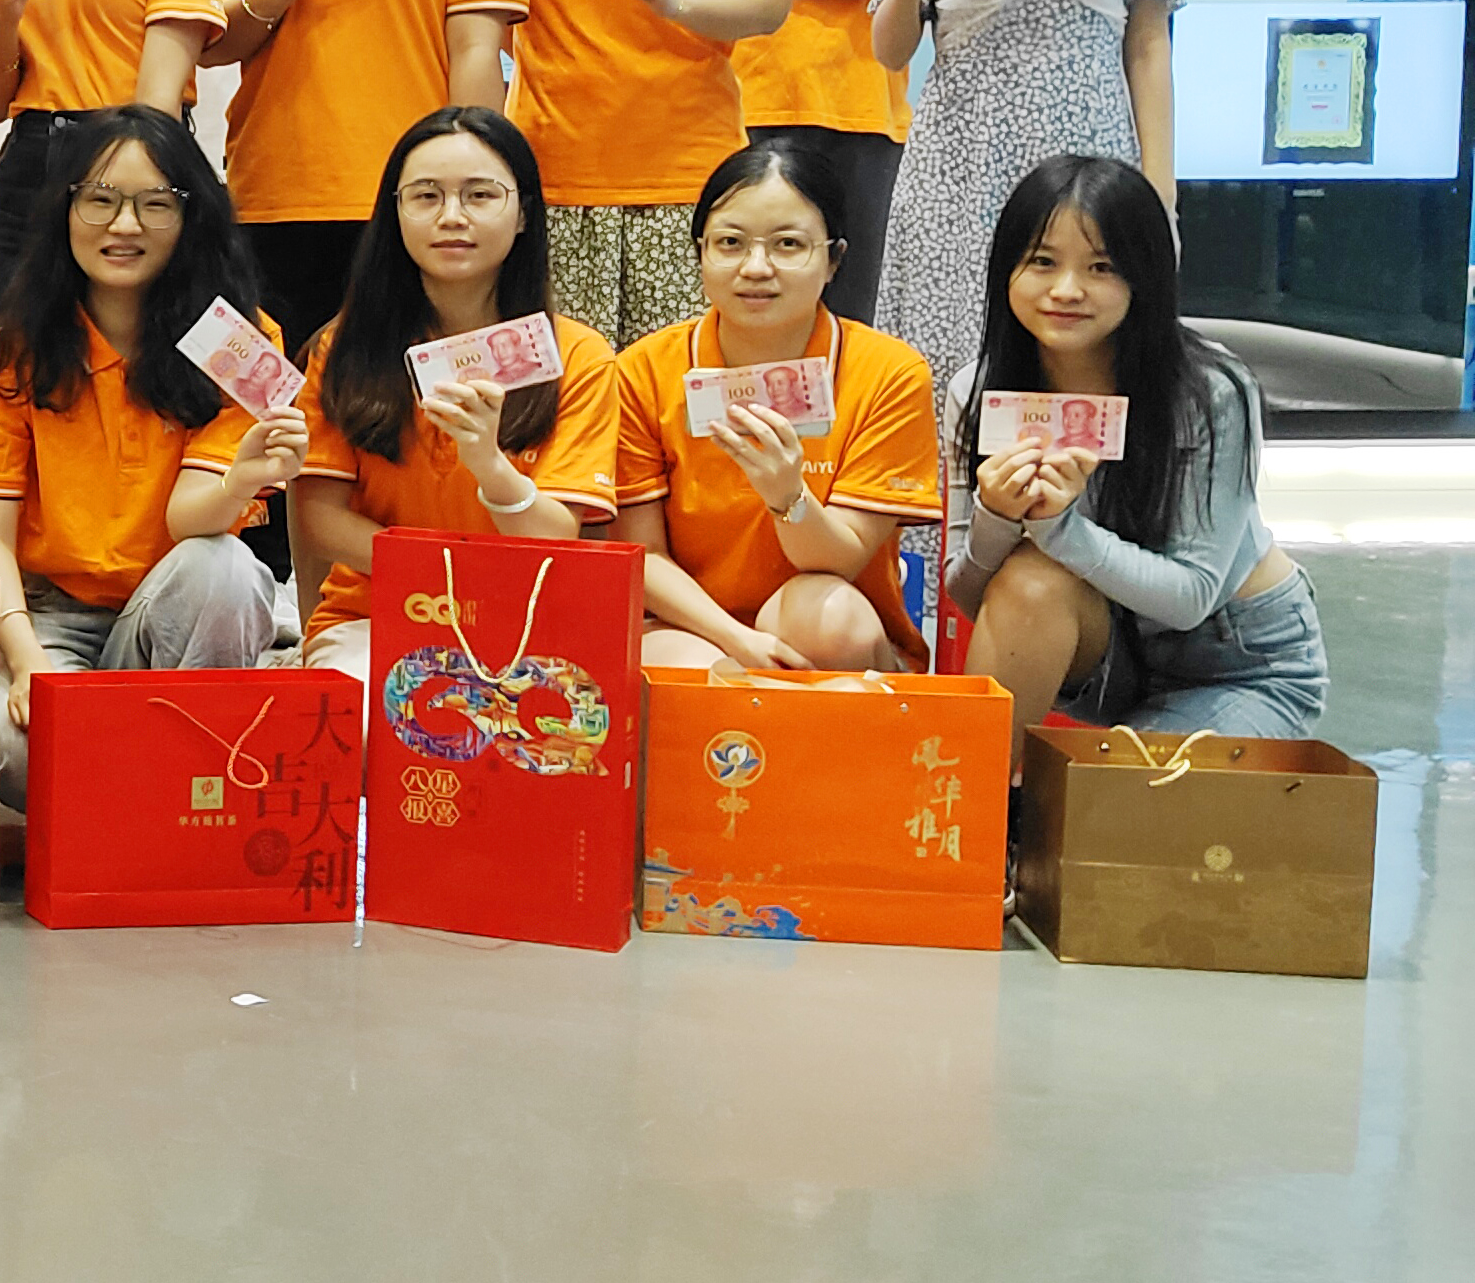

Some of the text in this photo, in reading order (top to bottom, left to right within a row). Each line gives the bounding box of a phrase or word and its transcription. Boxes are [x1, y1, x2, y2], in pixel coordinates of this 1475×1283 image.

[227, 338, 248, 359] 100
[455, 353, 481, 368] 100
[728, 387, 755, 399] 100
[1023, 412, 1050, 423] 100
[256, 693, 355, 912] 大吉大利
